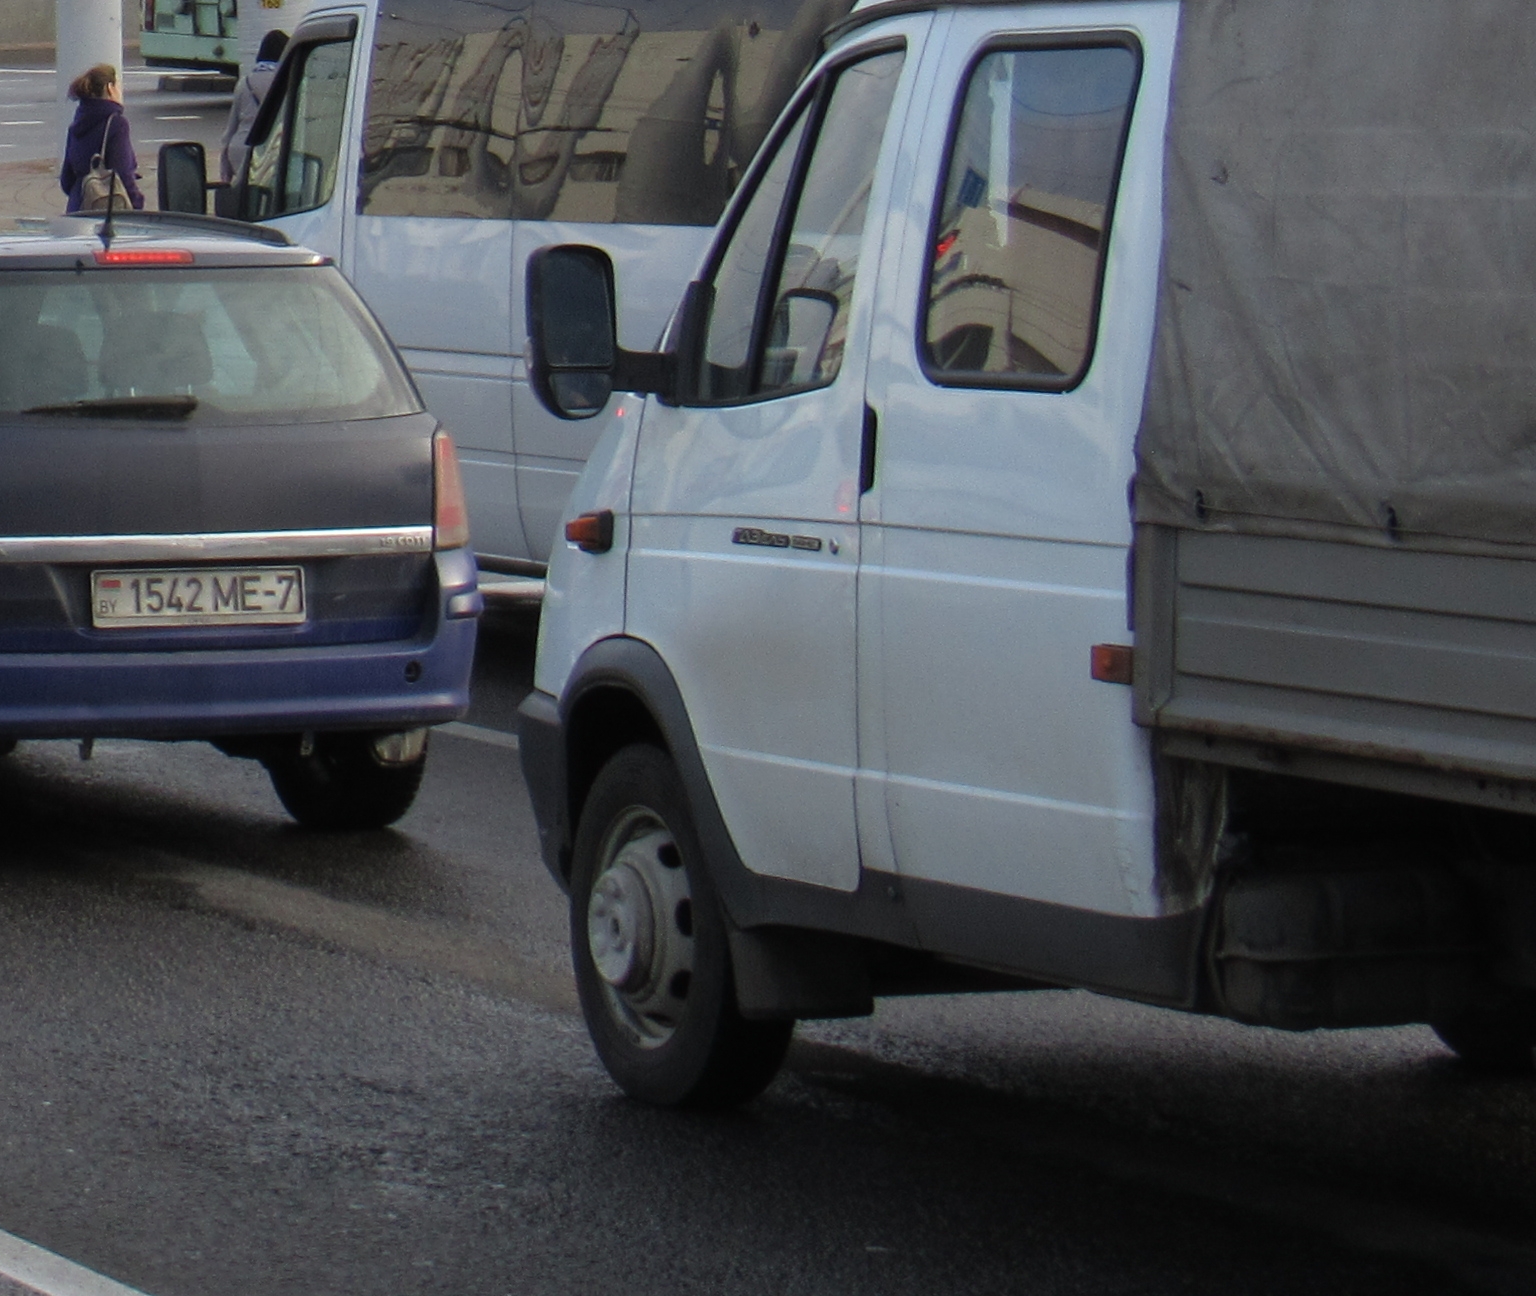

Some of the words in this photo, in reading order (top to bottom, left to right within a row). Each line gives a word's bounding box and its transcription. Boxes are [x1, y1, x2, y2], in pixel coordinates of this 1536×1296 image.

[100, 599, 117, 615] BY
[130, 577, 204, 614] 1542
[212, 575, 295, 612] ME-7
